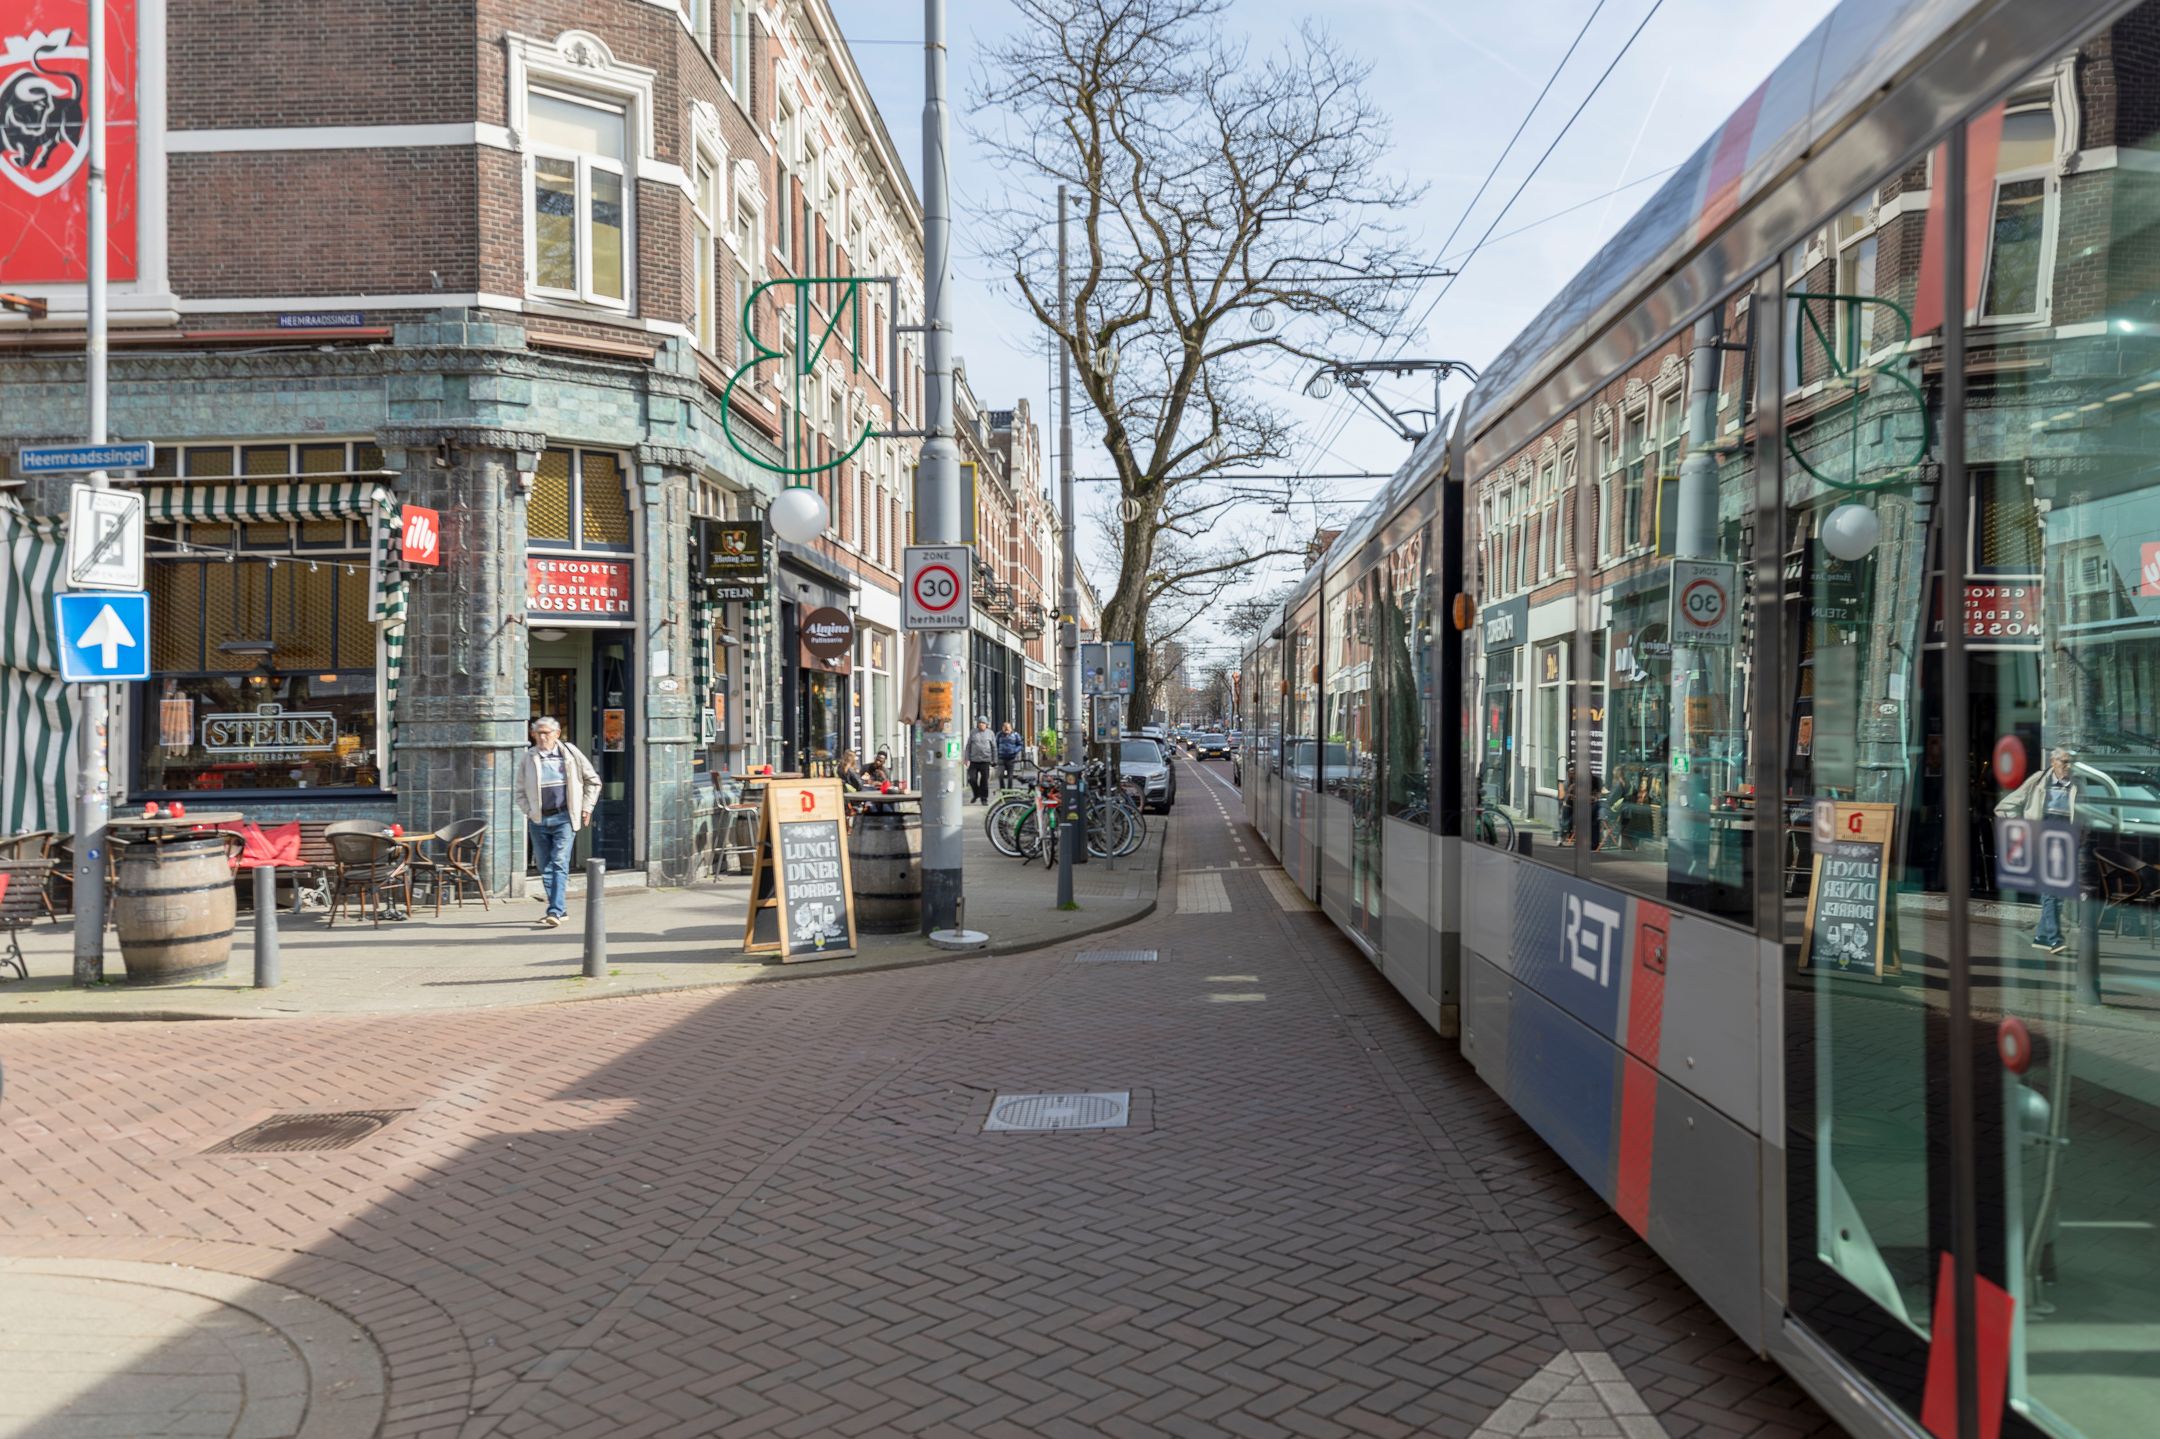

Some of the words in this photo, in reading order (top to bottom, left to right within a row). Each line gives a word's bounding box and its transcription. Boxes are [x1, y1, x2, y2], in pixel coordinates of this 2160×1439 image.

[281, 314, 361, 327] HEEMRAADSSINGEL
[24, 448, 145, 467] Heemraadssingel
[405, 515, 437, 558] illy
[922, 552, 951, 561] ZONE
[537, 561, 618, 576] GEKOOKTE
[537, 583, 618, 597] GEBAKKEN
[922, 580, 953, 597] 30
[526, 597, 629, 612] MOSSELEN
[909, 615, 965, 625] herhaling
[805, 622, 850, 637] Almina
[210, 720, 328, 746] STEIJN
[239, 753, 300, 762] ROTTERDAM
[785, 841, 837, 860] LUNCH
[787, 861, 839, 882] DINER
[788, 881, 841, 900] BORREL
